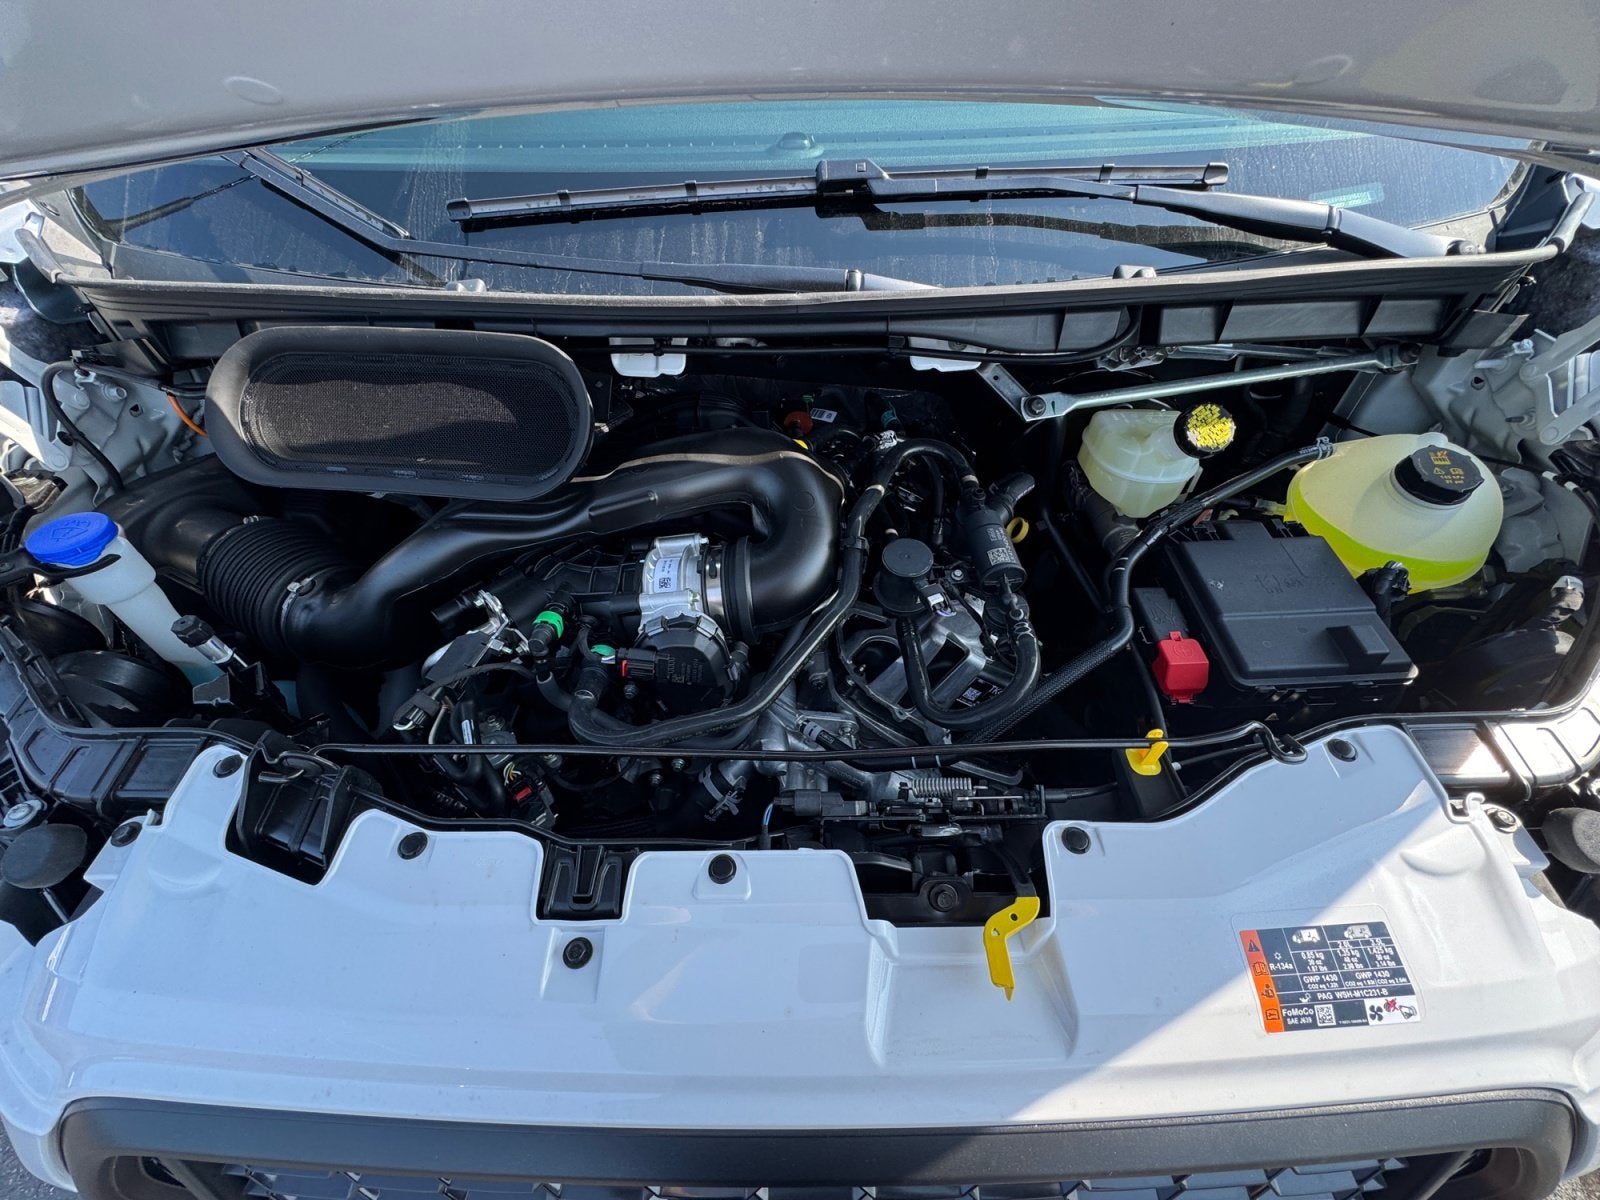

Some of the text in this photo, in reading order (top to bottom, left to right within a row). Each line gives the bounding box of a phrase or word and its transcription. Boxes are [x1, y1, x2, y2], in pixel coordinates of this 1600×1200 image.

[1337, 949, 1360, 958] 1.35 kg
[1367, 946, 1394, 955] 1.425 kg
[1316, 952, 1324, 961] kg
[1269, 963, 1293, 971] R-134a
[1303, 974, 1338, 984] GWP 1430
[1355, 970, 1390, 979] GWP 1430
[1317, 988, 1389, 999] PAG WSH-M1C231-B
[1282, 1007, 1314, 1016] FoMoCo
